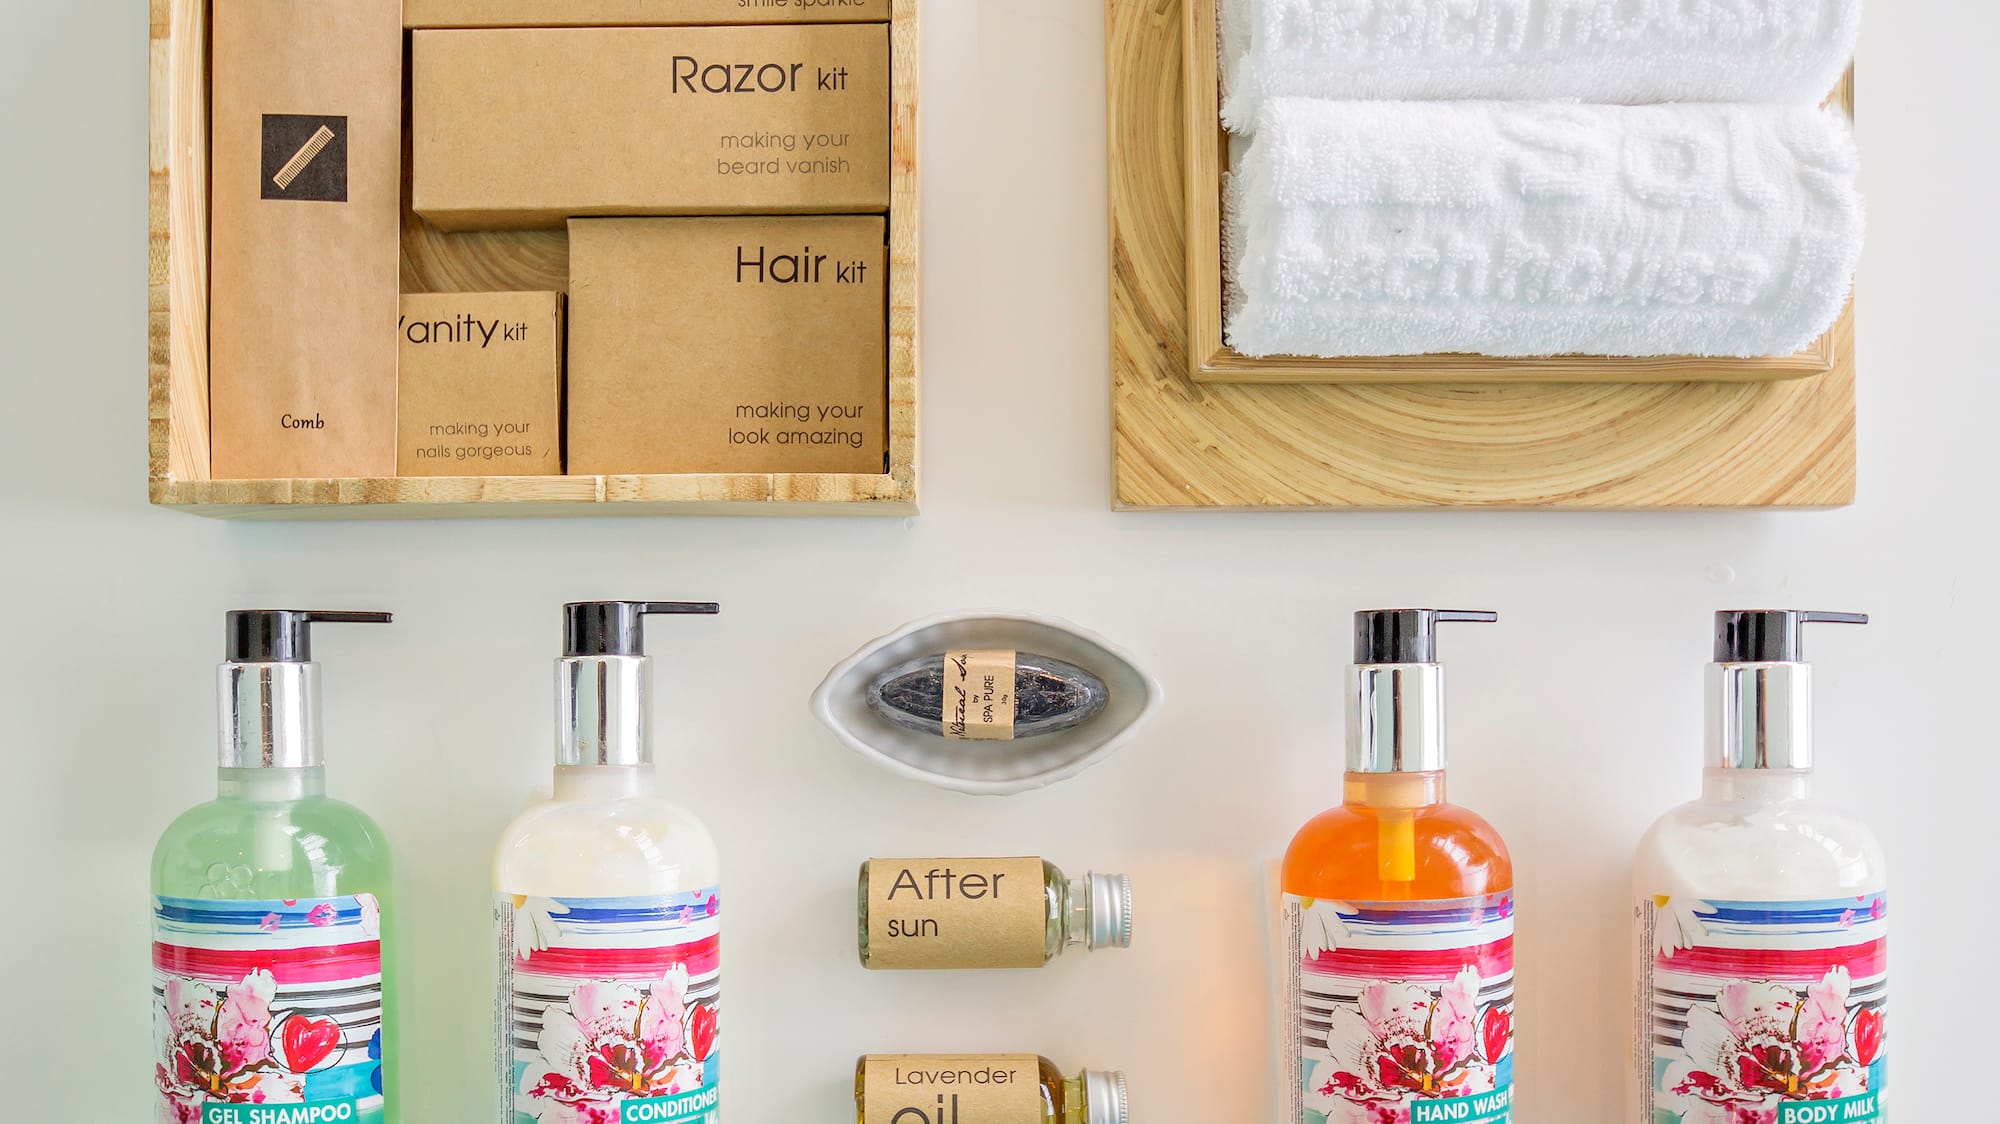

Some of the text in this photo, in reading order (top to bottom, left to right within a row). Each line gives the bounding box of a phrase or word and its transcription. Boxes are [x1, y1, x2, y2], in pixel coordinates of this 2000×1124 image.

[673, 56, 848, 93] Razor kit
[721, 131, 850, 151] making your
[718, 157, 849, 174] beard vanish
[737, 246, 866, 283] Hair kit
[504, 323, 527, 341] kit
[282, 413, 324, 429] Comb
[737, 402, 863, 422] making your
[430, 422, 530, 437] making your
[729, 428, 862, 448] look amazing
[416, 444, 531, 460] nails gorgeous
[950, 654, 967, 682] Soa
[972, 694, 980, 704] by
[982, 674, 995, 723] SPA PURE
[888, 869, 1005, 900] After
[888, 919, 937, 937] sun
[896, 1067, 1016, 1084] Lavender
[208, 1103, 351, 1124] GEL SHAMPOO
[1416, 1090, 1508, 1122] HAND WASH
[1784, 1096, 1875, 1124] BODY MILK
